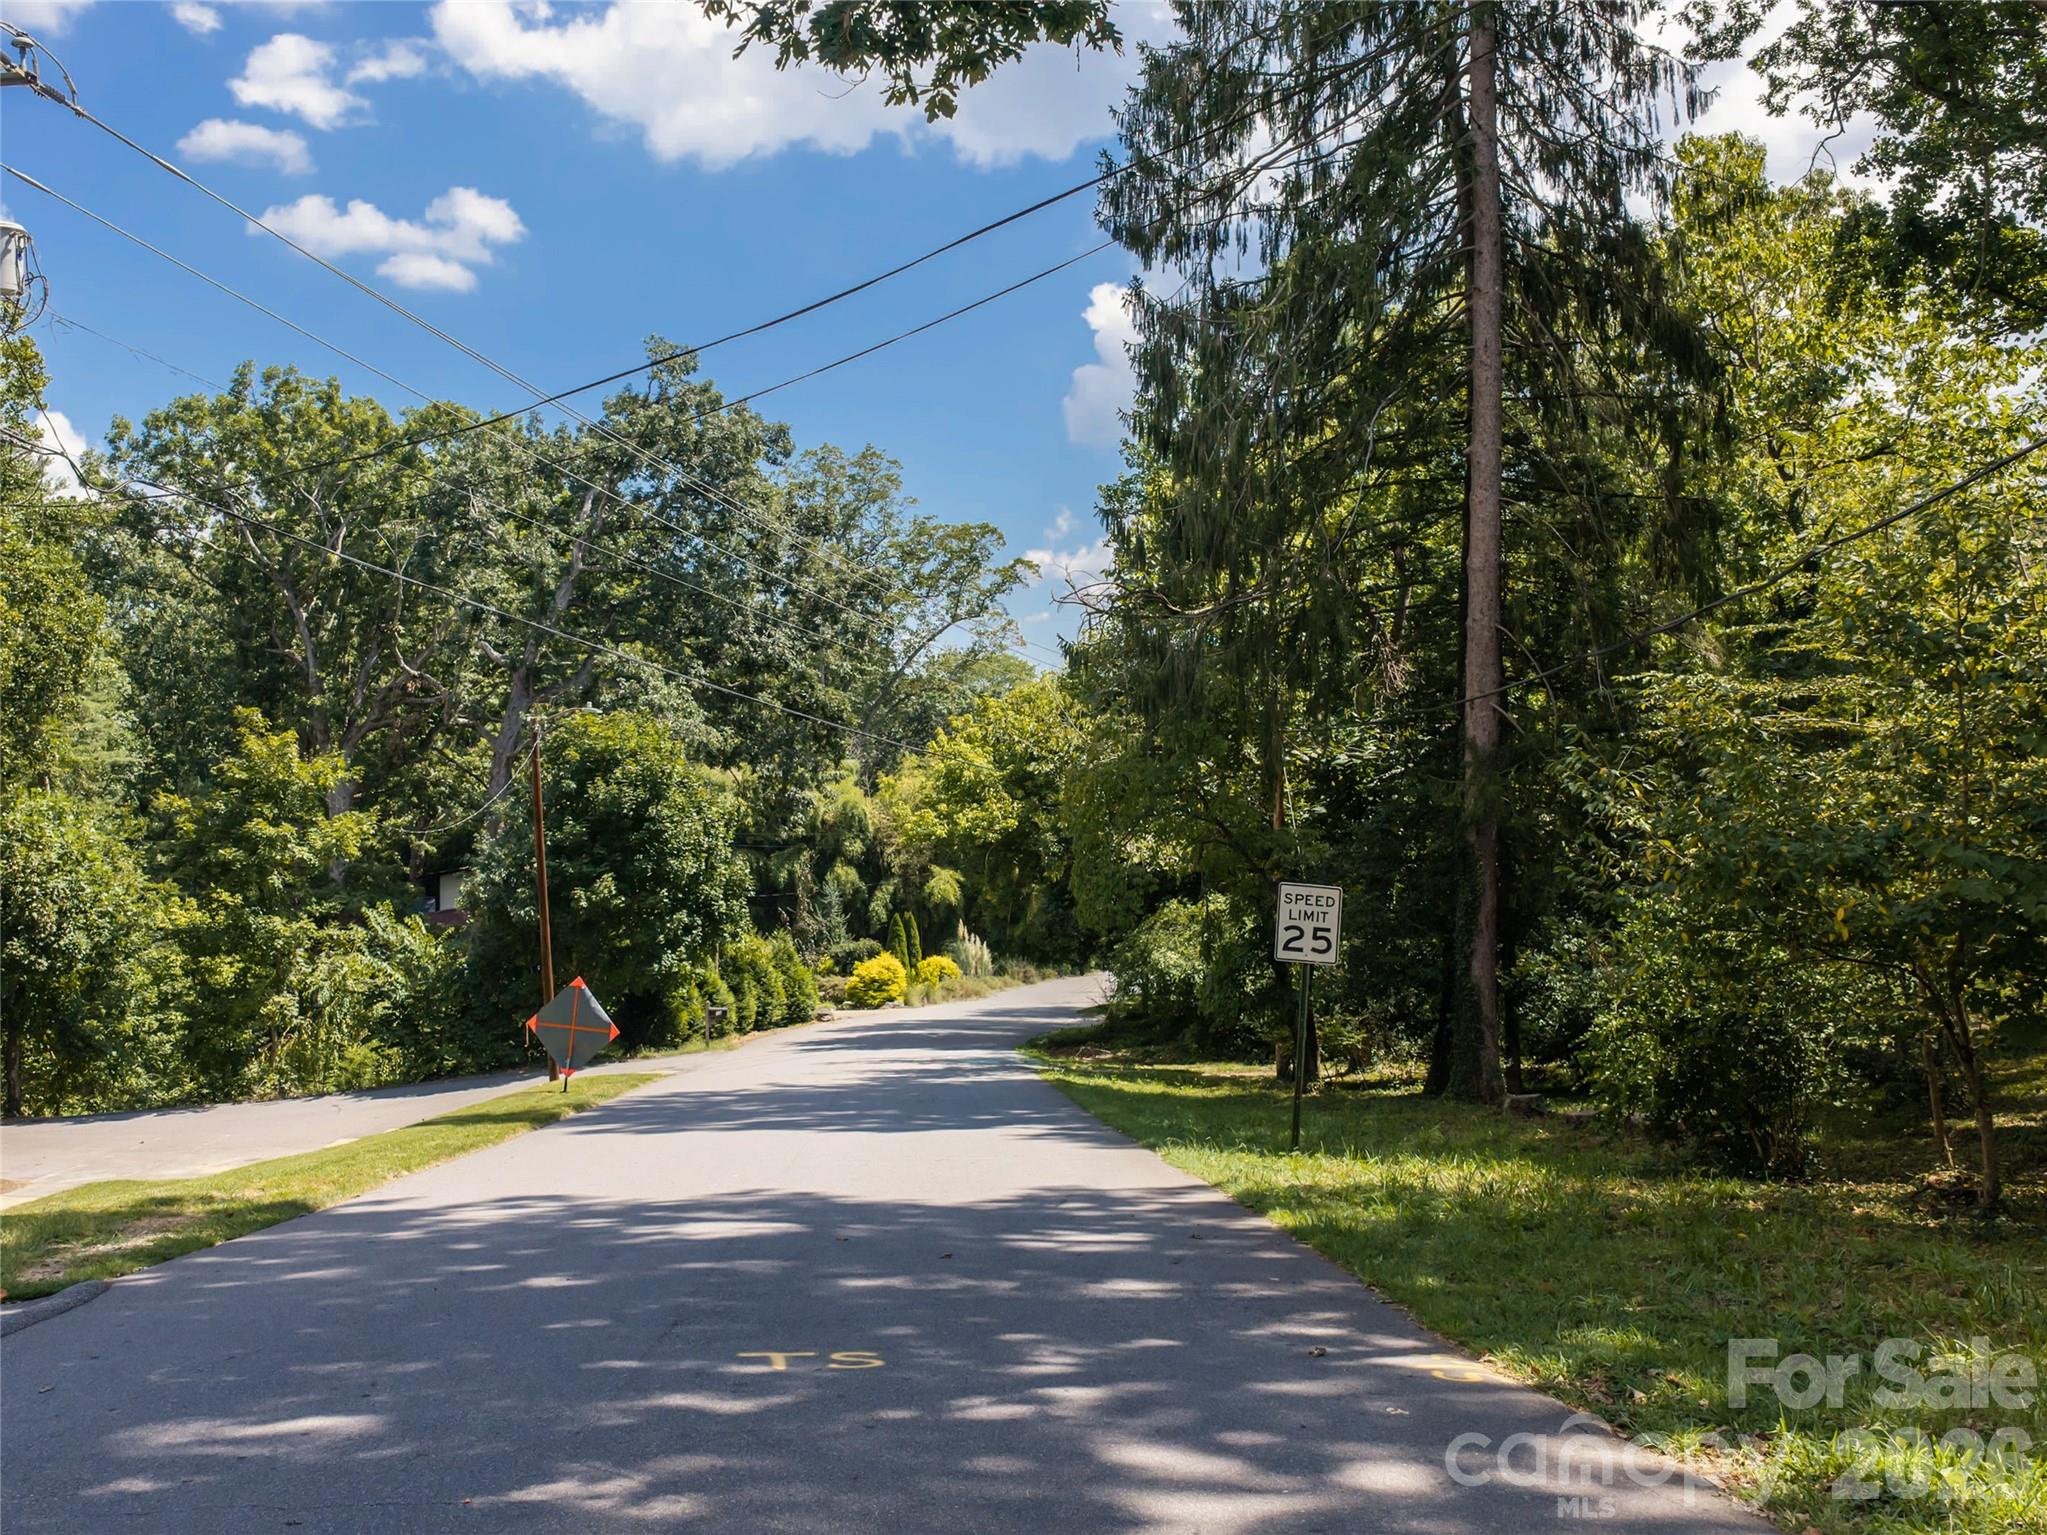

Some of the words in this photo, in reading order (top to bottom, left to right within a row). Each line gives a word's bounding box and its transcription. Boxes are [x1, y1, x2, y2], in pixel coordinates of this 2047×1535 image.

[1284, 893, 1335, 907] SPEED
[1289, 909, 1328, 923] LIMIT
[1282, 925, 1332, 954] 25
